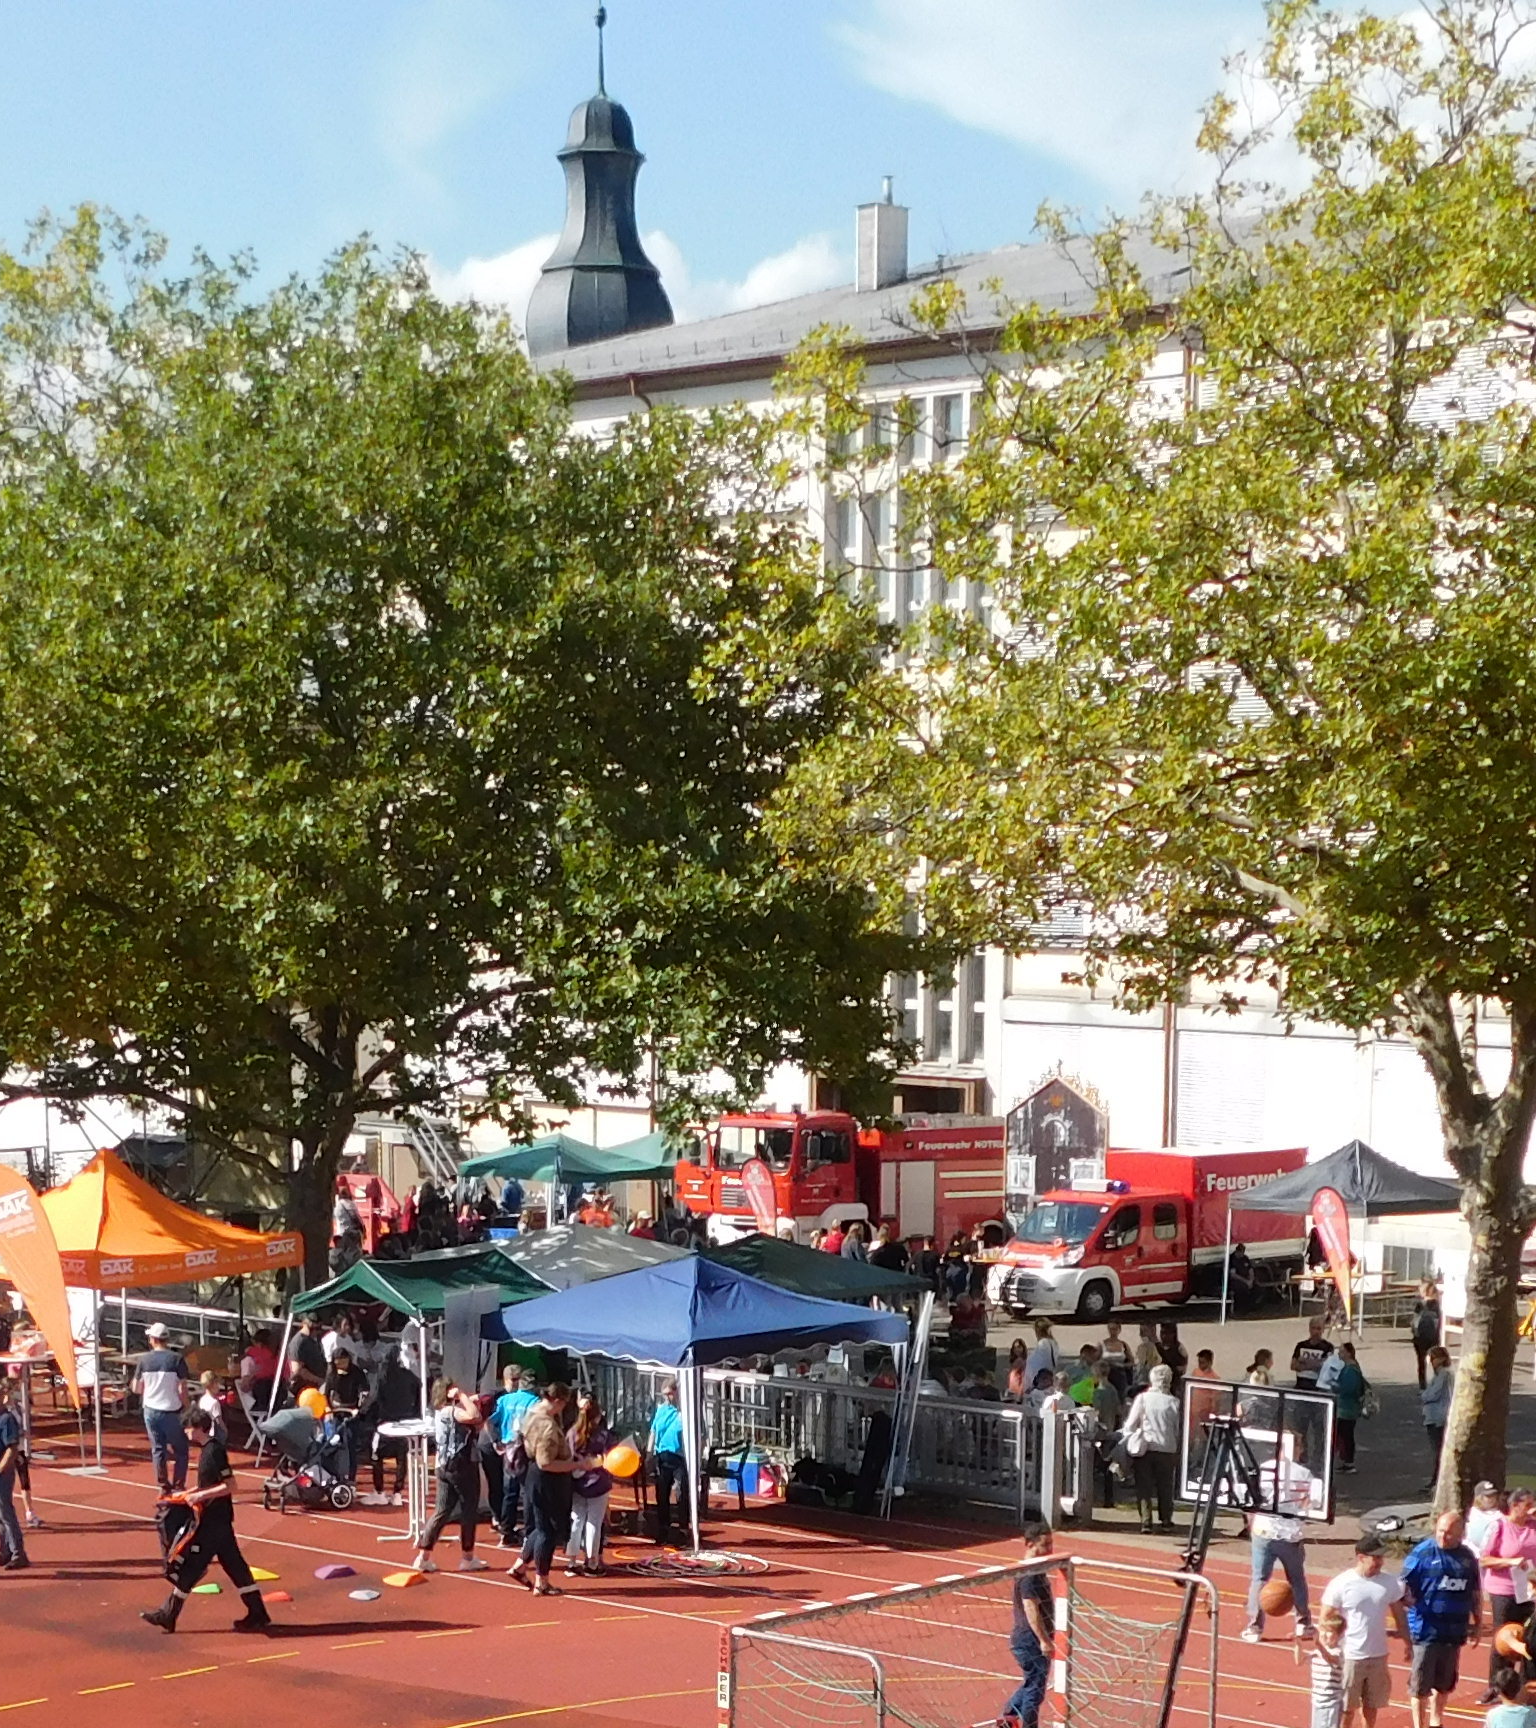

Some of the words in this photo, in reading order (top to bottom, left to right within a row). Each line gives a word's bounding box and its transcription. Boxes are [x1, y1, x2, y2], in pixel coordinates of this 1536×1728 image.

[266, 1238, 297, 1256] DAK
[100, 1258, 135, 1276] DAK
[185, 1250, 218, 1267] DAK
